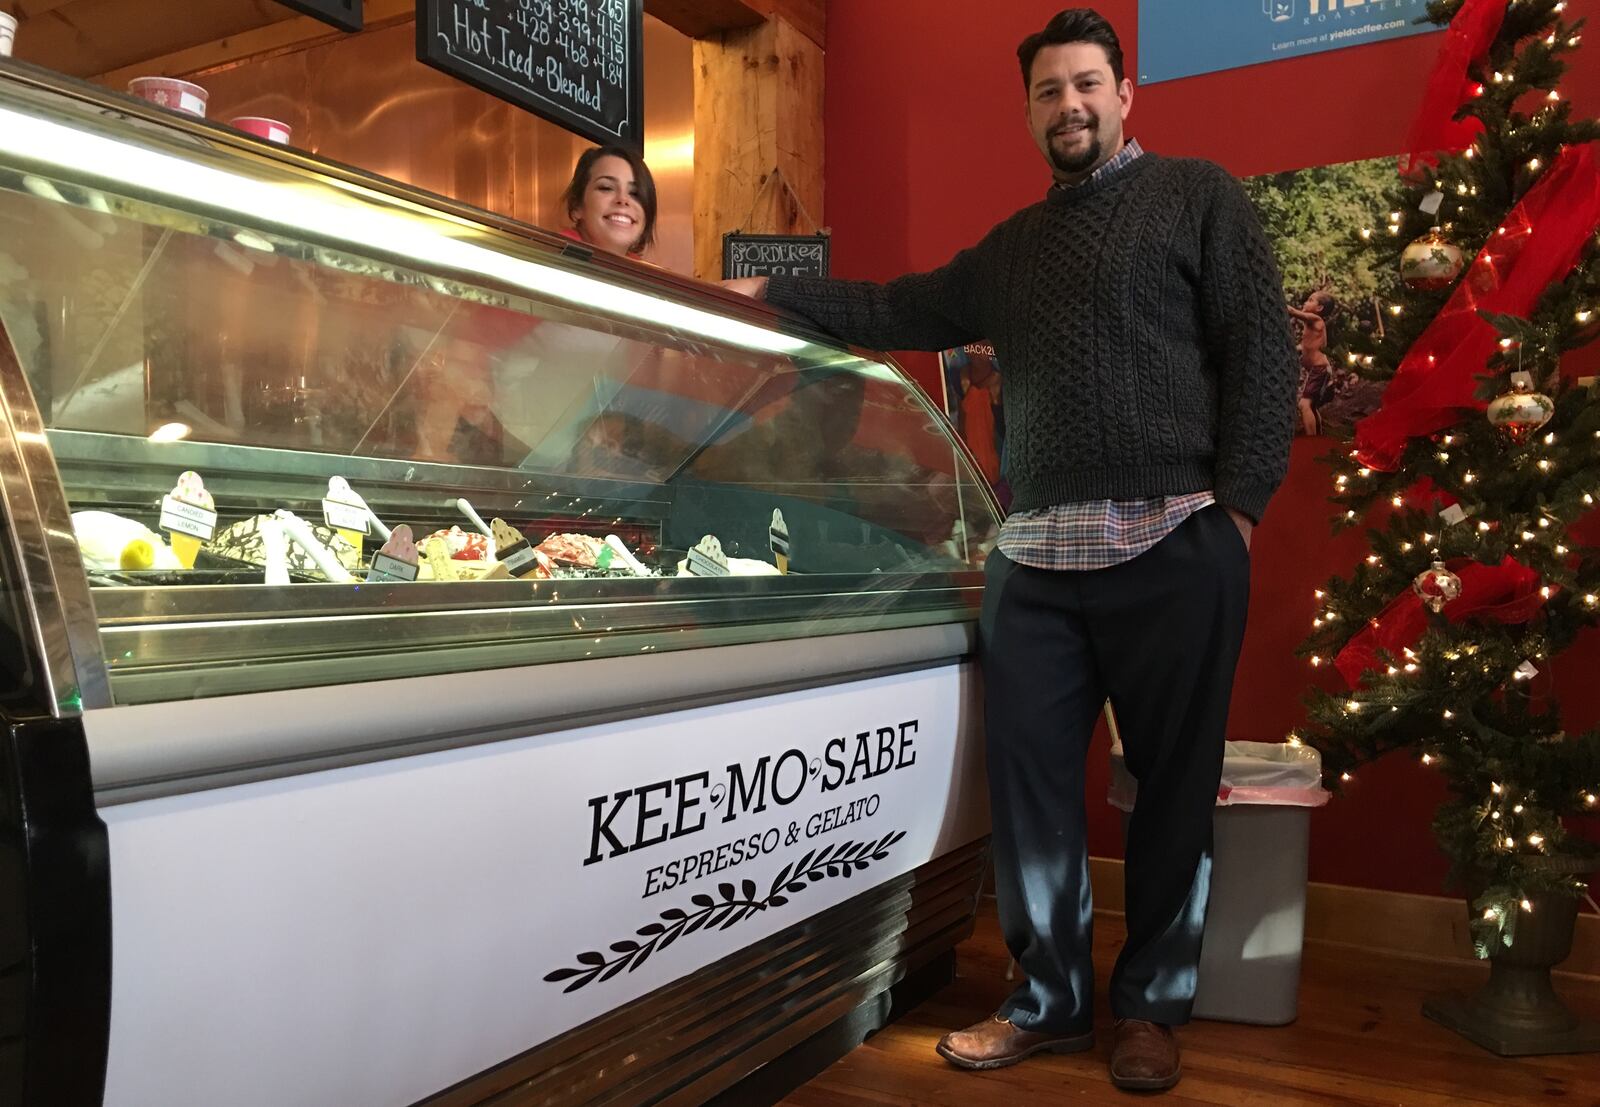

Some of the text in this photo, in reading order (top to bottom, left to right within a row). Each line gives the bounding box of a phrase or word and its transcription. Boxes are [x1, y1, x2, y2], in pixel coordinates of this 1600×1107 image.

[517, 10, 550, 46] 4.28
[597, 57, 623, 88] 4.84
[558, 11, 590, 46] 3.99
[597, 35, 624, 65] 4.15
[597, 13, 623, 45] 4.15
[1272, 19, 1405, 50] Learn more at yieldcoffee.com
[536, 64, 545, 78] or
[546, 56, 601, 112] Blended
[177, 520, 199, 532] LEMON
[642, 794, 881, 899] ESPRESSO & GELATO
